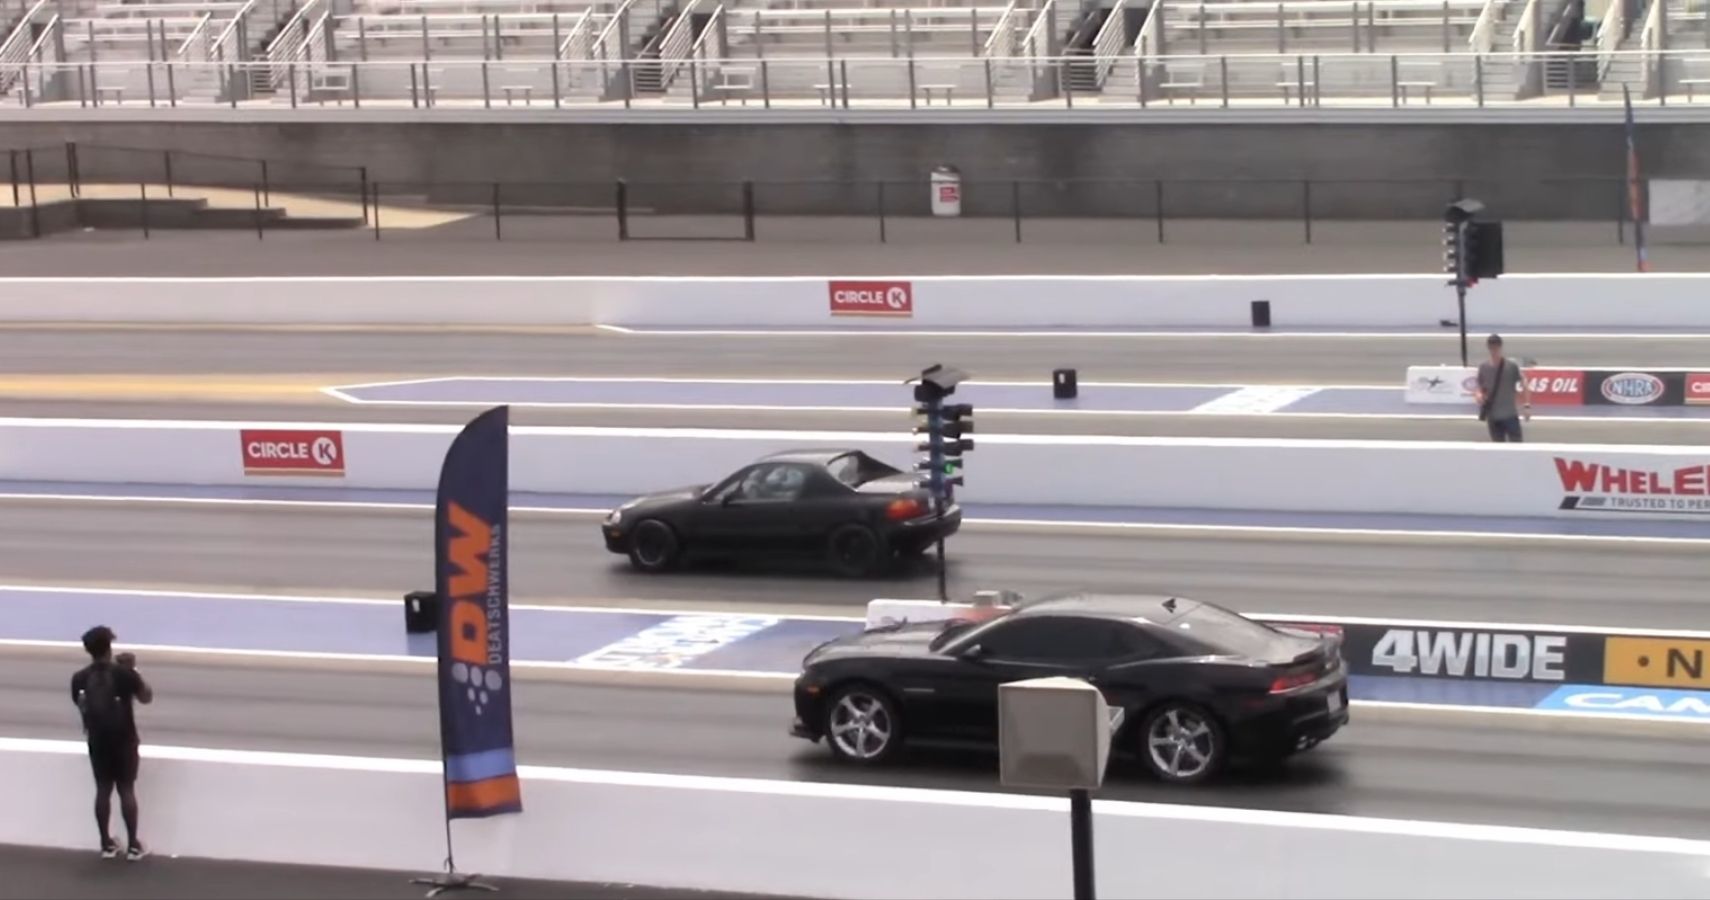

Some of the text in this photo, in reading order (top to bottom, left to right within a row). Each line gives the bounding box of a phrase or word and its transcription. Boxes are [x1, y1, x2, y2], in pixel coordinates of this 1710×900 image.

[834, 290, 884, 304] CIRCLE
[1551, 378, 1579, 393] OIL
[1611, 379, 1654, 398] NHRA
[247, 441, 309, 458] CIRCLE
[1553, 457, 1710, 495] WHELE
[1610, 497, 1666, 508] TRUSTED
[1670, 499, 1686, 509] TO
[448, 499, 492, 665] DW
[1372, 629, 1567, 680] 4WIDE
